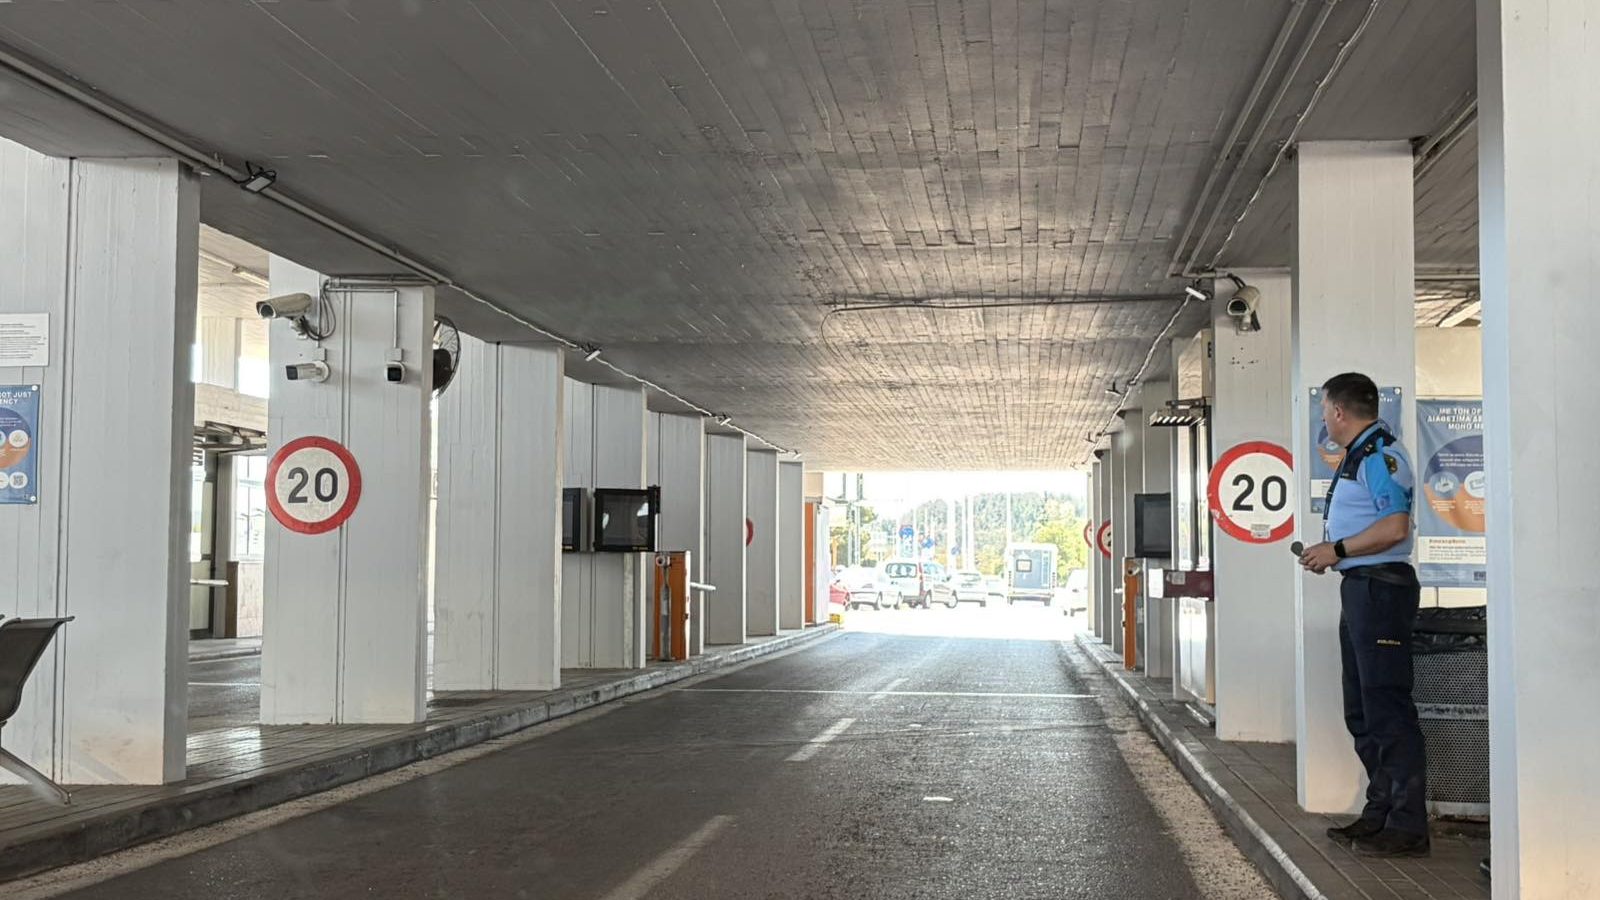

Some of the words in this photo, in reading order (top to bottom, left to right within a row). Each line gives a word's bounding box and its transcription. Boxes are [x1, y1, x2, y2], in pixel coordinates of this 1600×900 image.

[1448, 423, 1472, 431] ΜΟΝΟ
[288, 467, 338, 504] 20
[1232, 474, 1287, 512] 20
